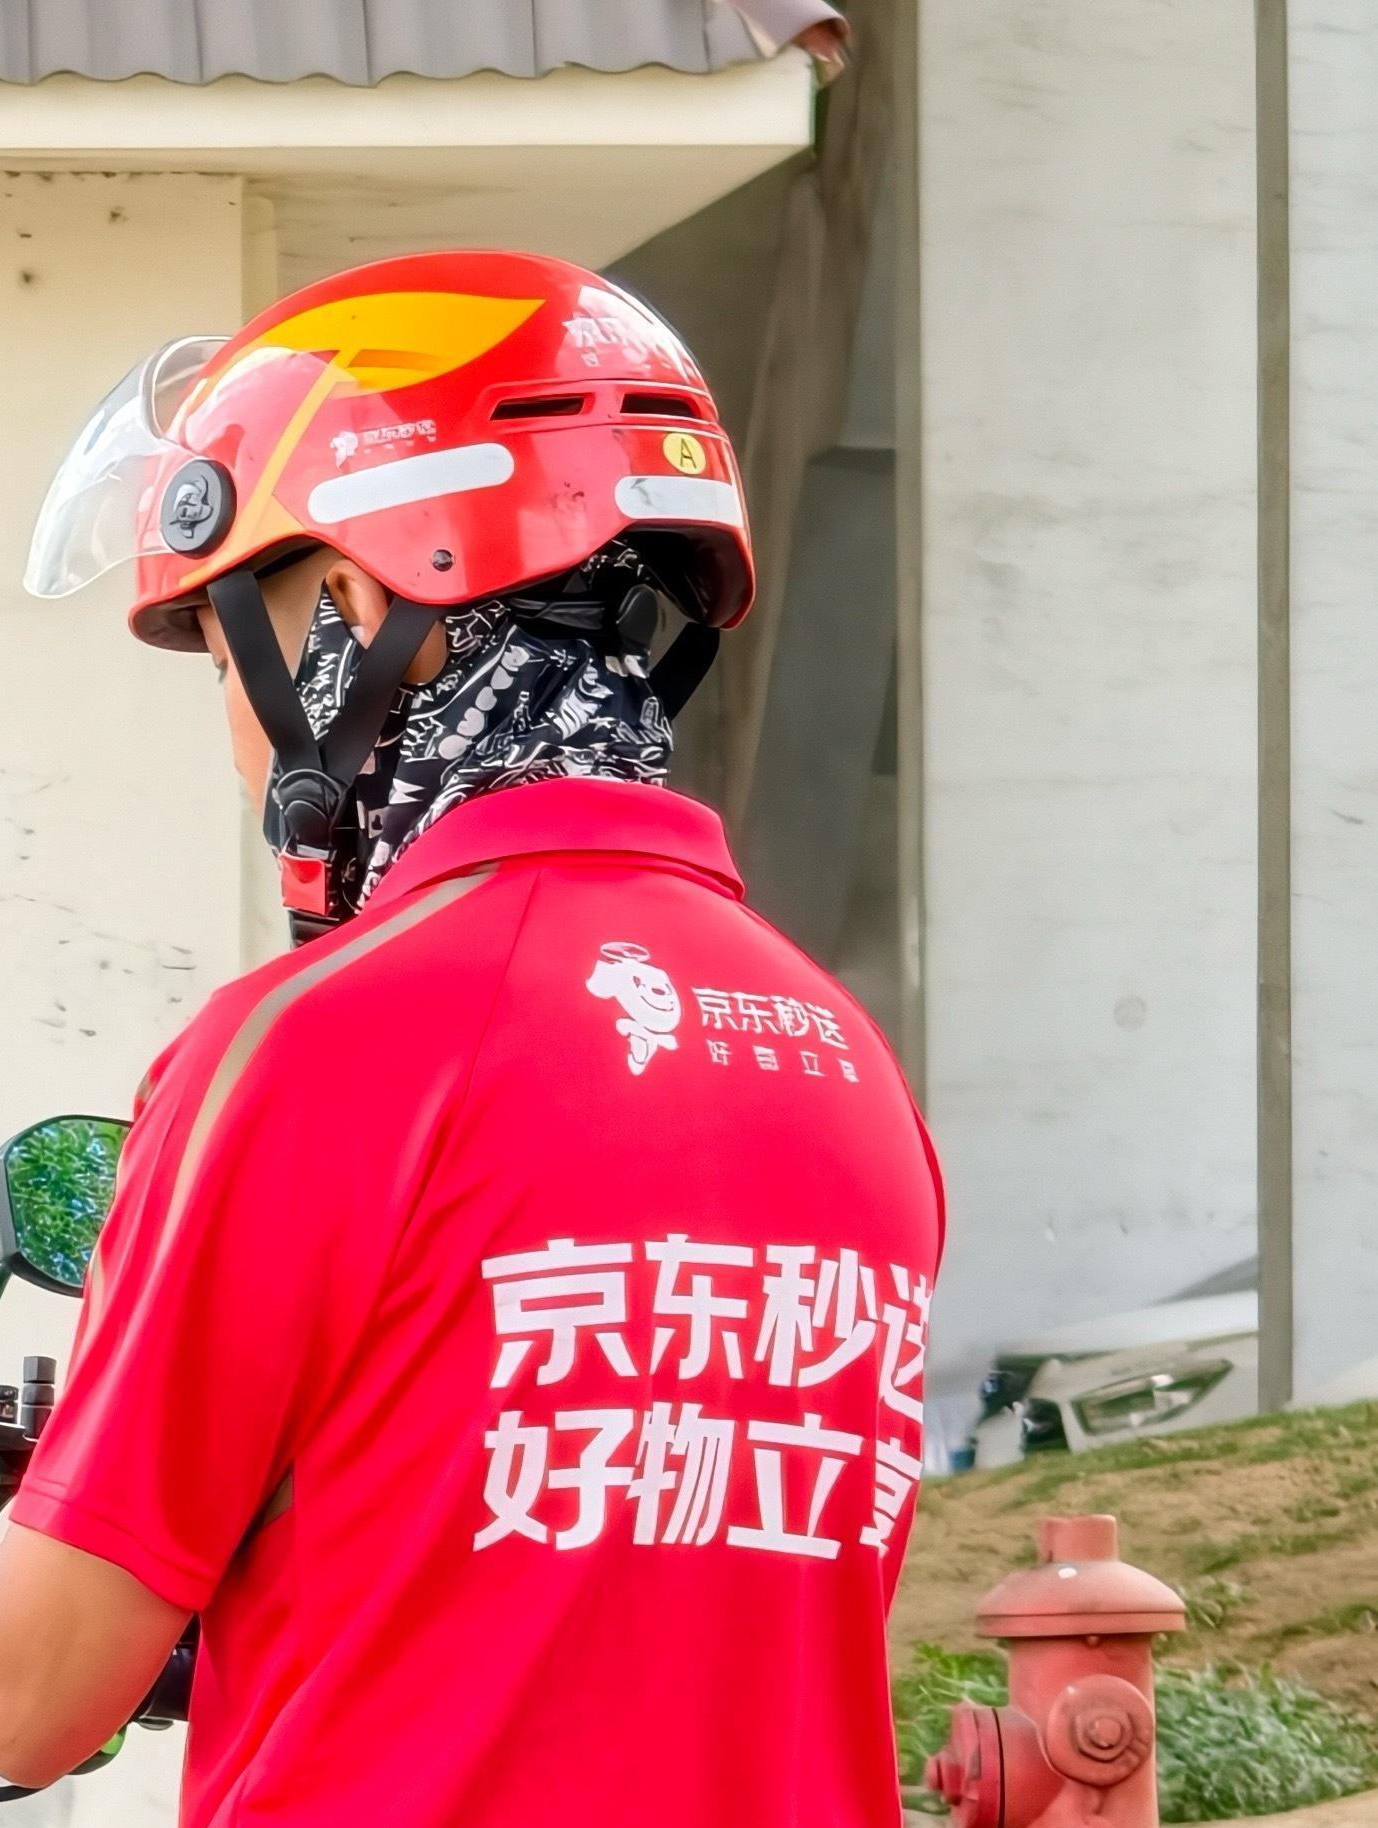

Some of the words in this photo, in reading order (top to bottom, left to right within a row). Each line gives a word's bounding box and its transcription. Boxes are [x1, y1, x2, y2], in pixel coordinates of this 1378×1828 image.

[678, 437, 698, 470] A
[691, 986, 850, 1050] 京东秒送
